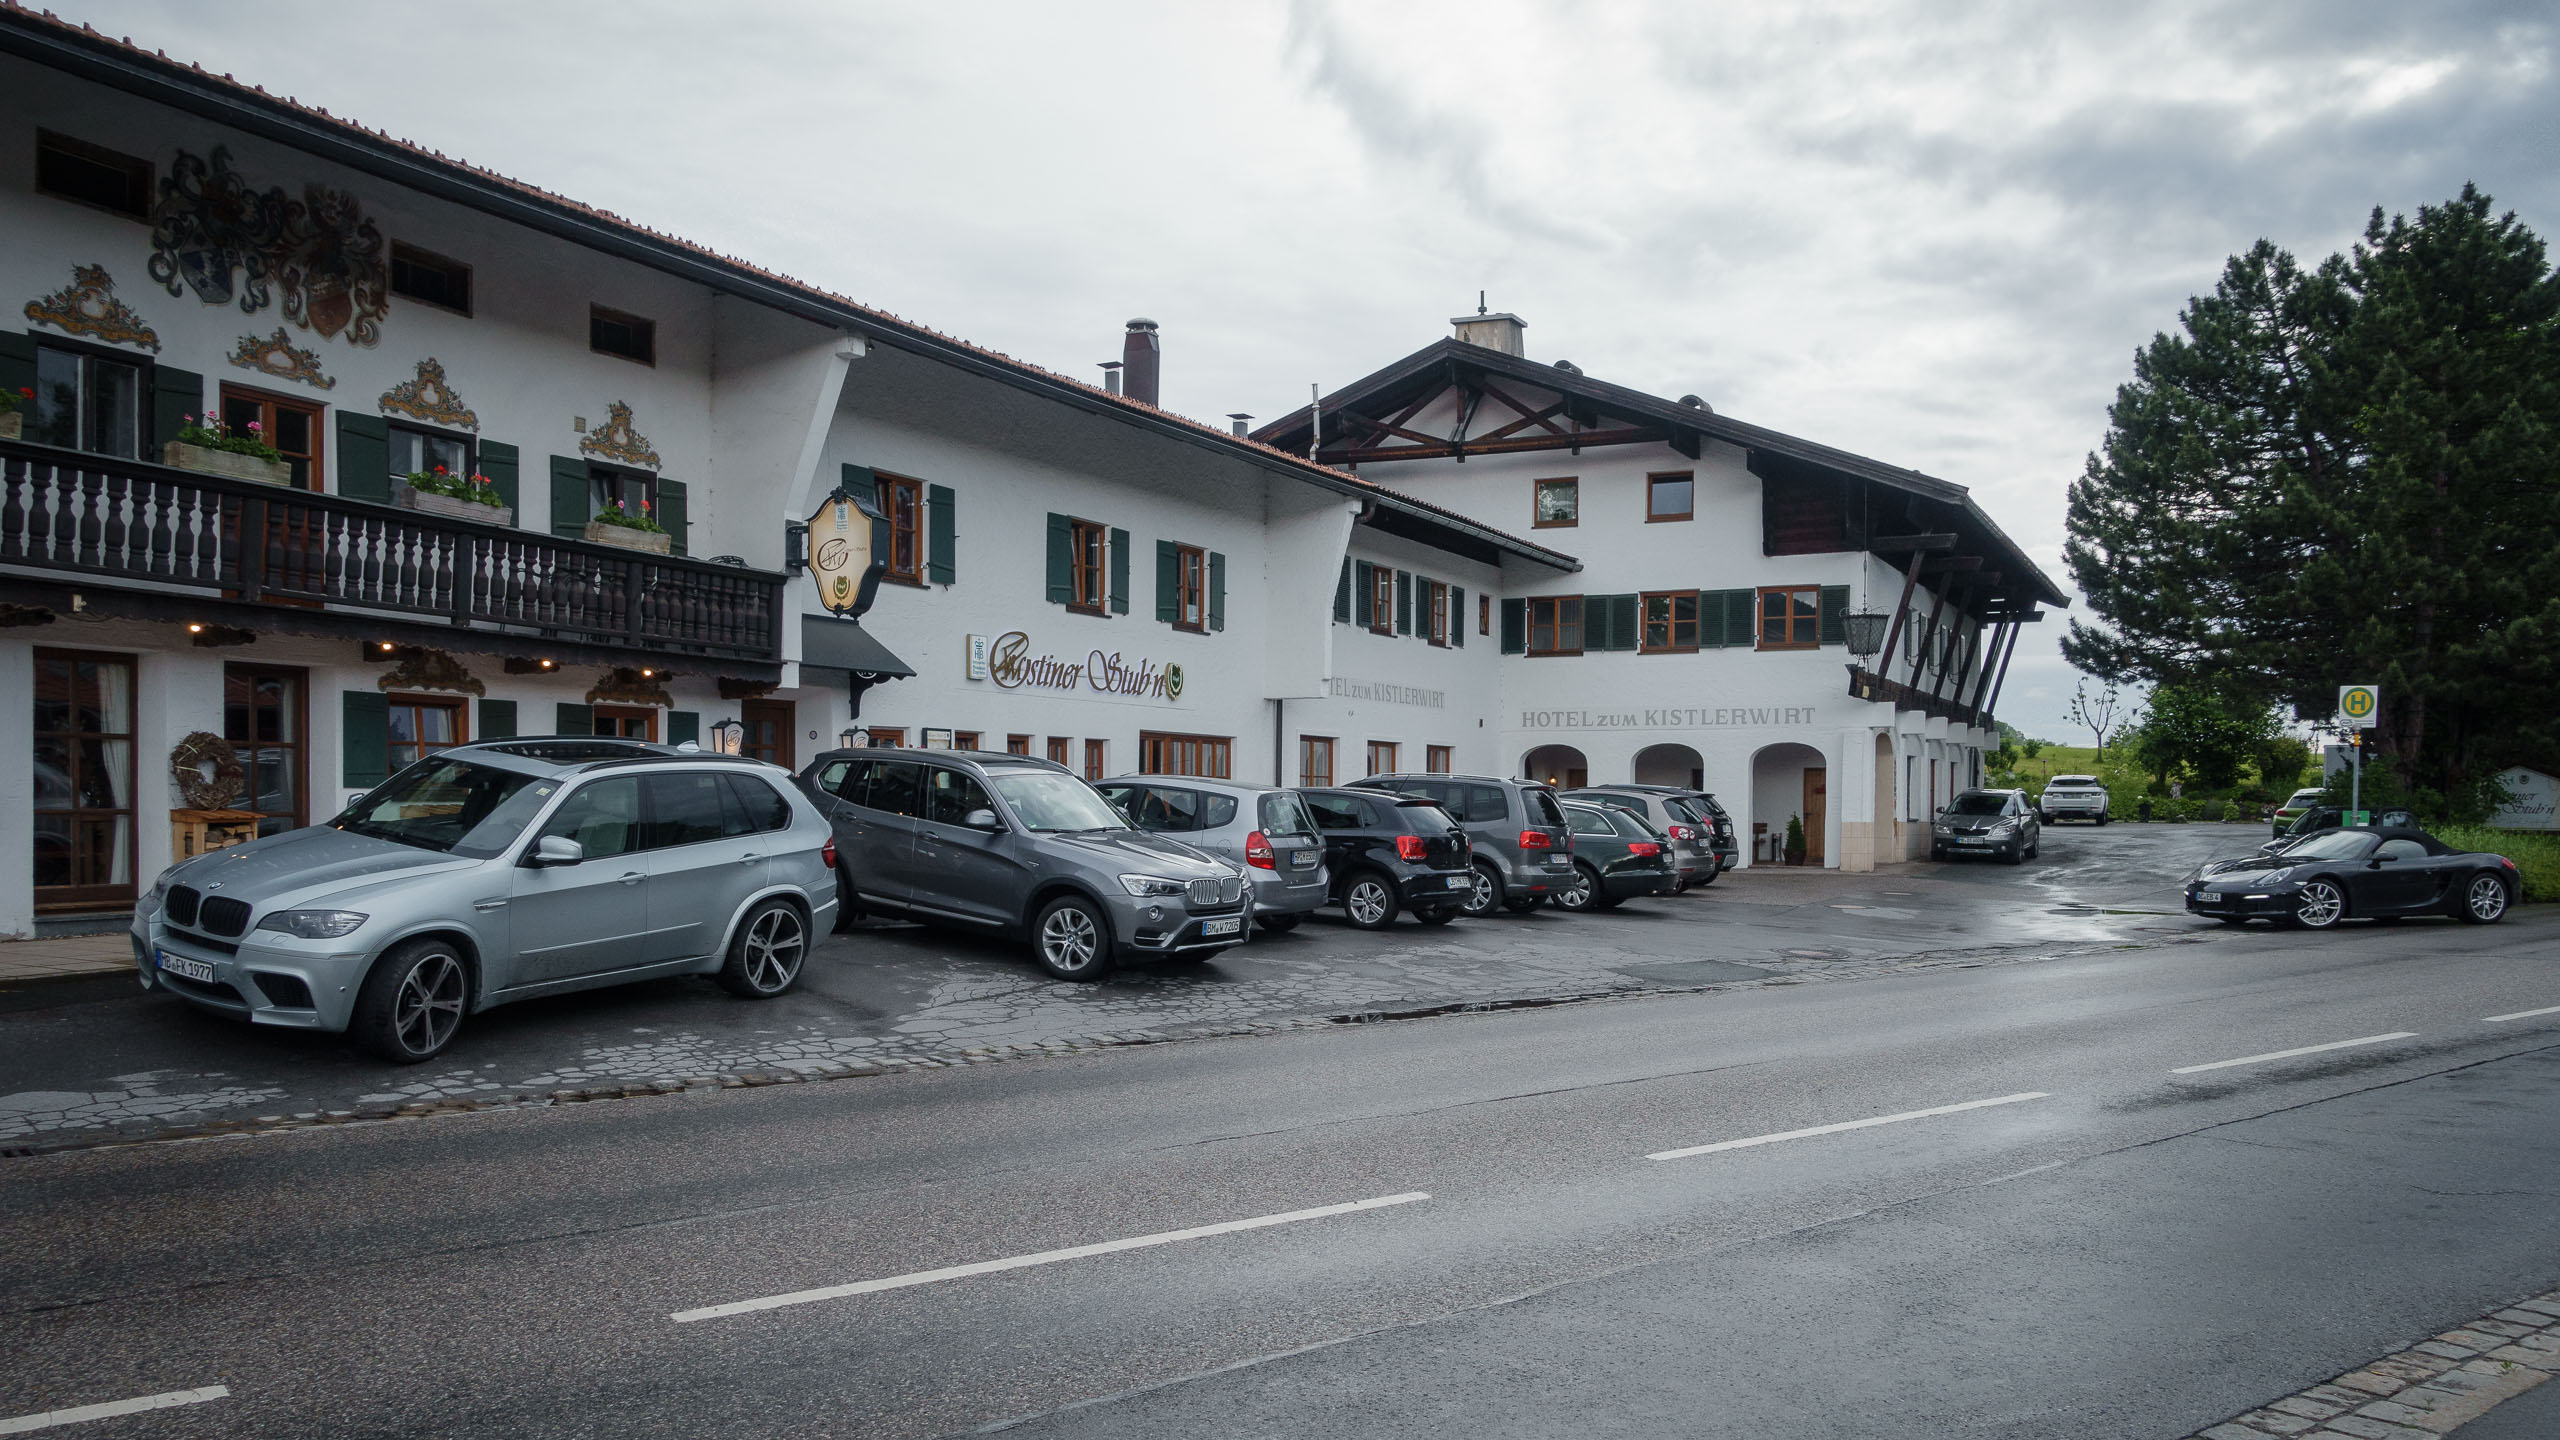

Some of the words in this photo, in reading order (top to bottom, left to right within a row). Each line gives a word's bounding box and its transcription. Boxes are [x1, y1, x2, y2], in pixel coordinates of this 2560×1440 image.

[1088, 649, 1165, 698] Stub'n
[1330, 676, 1351, 697] TEL
[1351, 685, 1372, 700] ZUM
[1374, 683, 1445, 709] KISTLERWIRT
[2351, 694, 2366, 711] H
[1521, 710, 1594, 728] HOTEL
[1597, 714, 1638, 727] ZUM
[1644, 707, 1816, 727] KISTLERWIRT
[175, 958, 187, 974] FK
[188, 962, 211, 980] 1977
